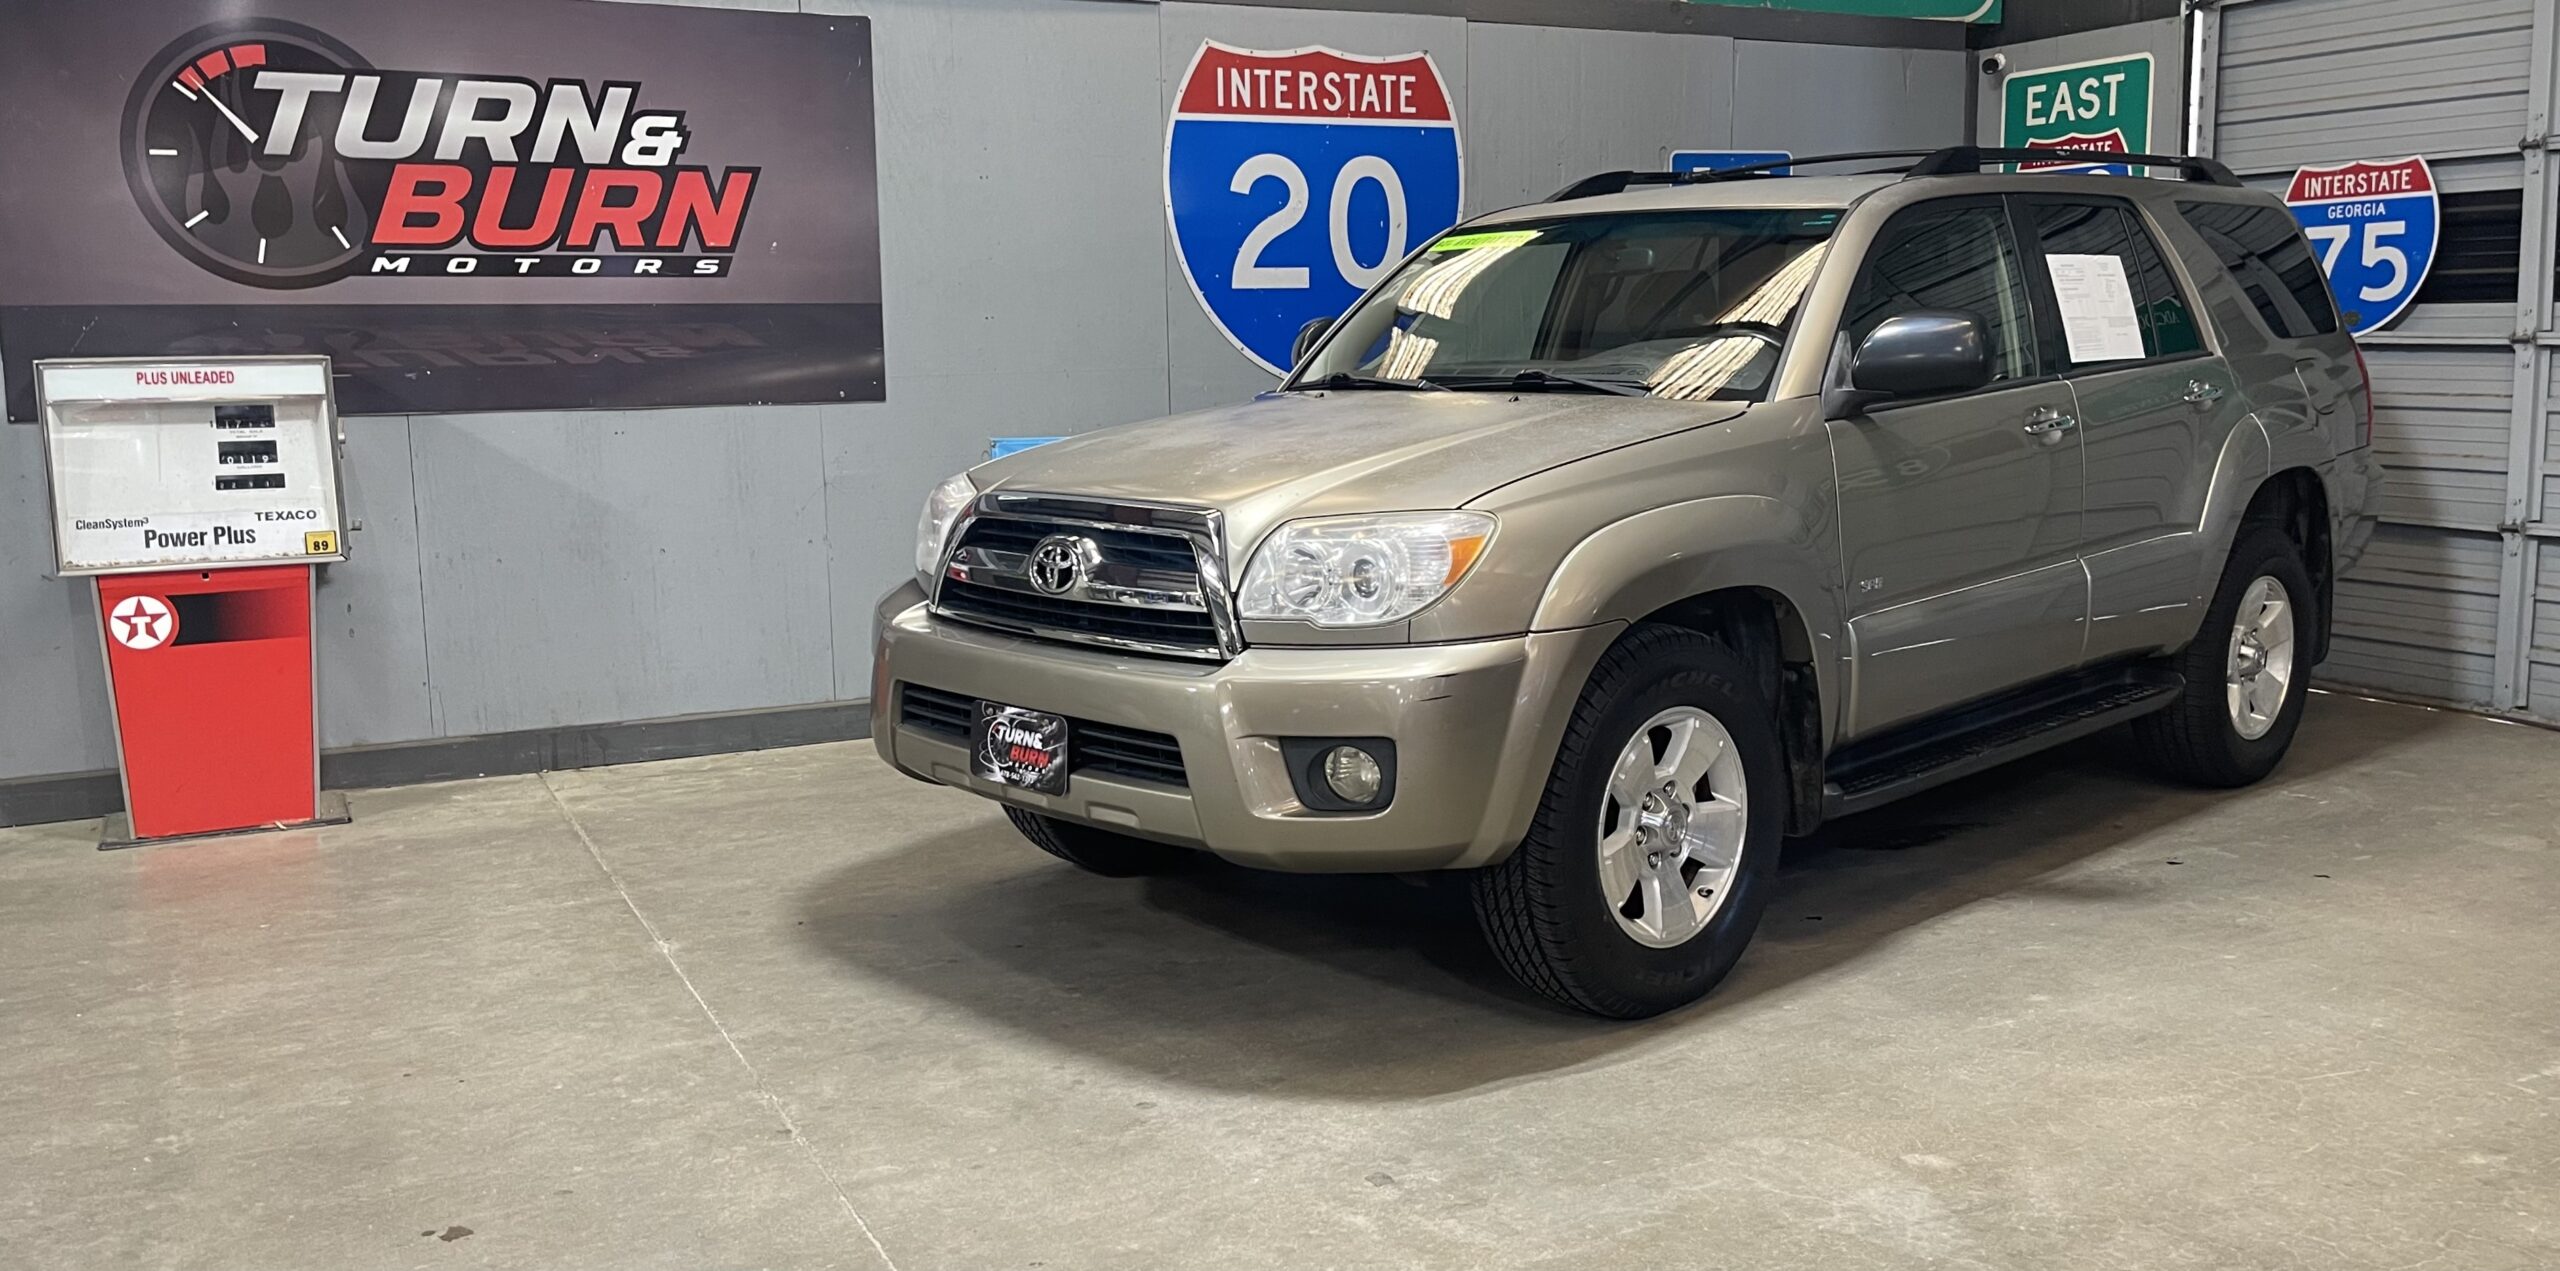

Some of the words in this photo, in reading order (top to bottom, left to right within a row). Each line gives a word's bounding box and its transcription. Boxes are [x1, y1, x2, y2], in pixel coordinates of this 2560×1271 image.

[1217, 67, 1417, 113] INTERSTATE
[2026, 73, 2125, 127] EAST
[2304, 168, 2412, 198] INTERSTATE
[371, 163, 753, 248] BURN
[2327, 202, 2386, 219] GEORGIA
[1230, 153, 1408, 289] 20
[371, 256, 719, 275] MOTORS
[2304, 220, 2408, 302] 75
[136, 371, 168, 385] PLUS
[170, 371, 235, 385] UNLEADED
[255, 510, 317, 522] TEXACO
[144, 528, 208, 548] Power
[213, 526, 256, 545] Plus
[313, 540, 329, 551] 89
[1010, 745, 1049, 768] BURN
